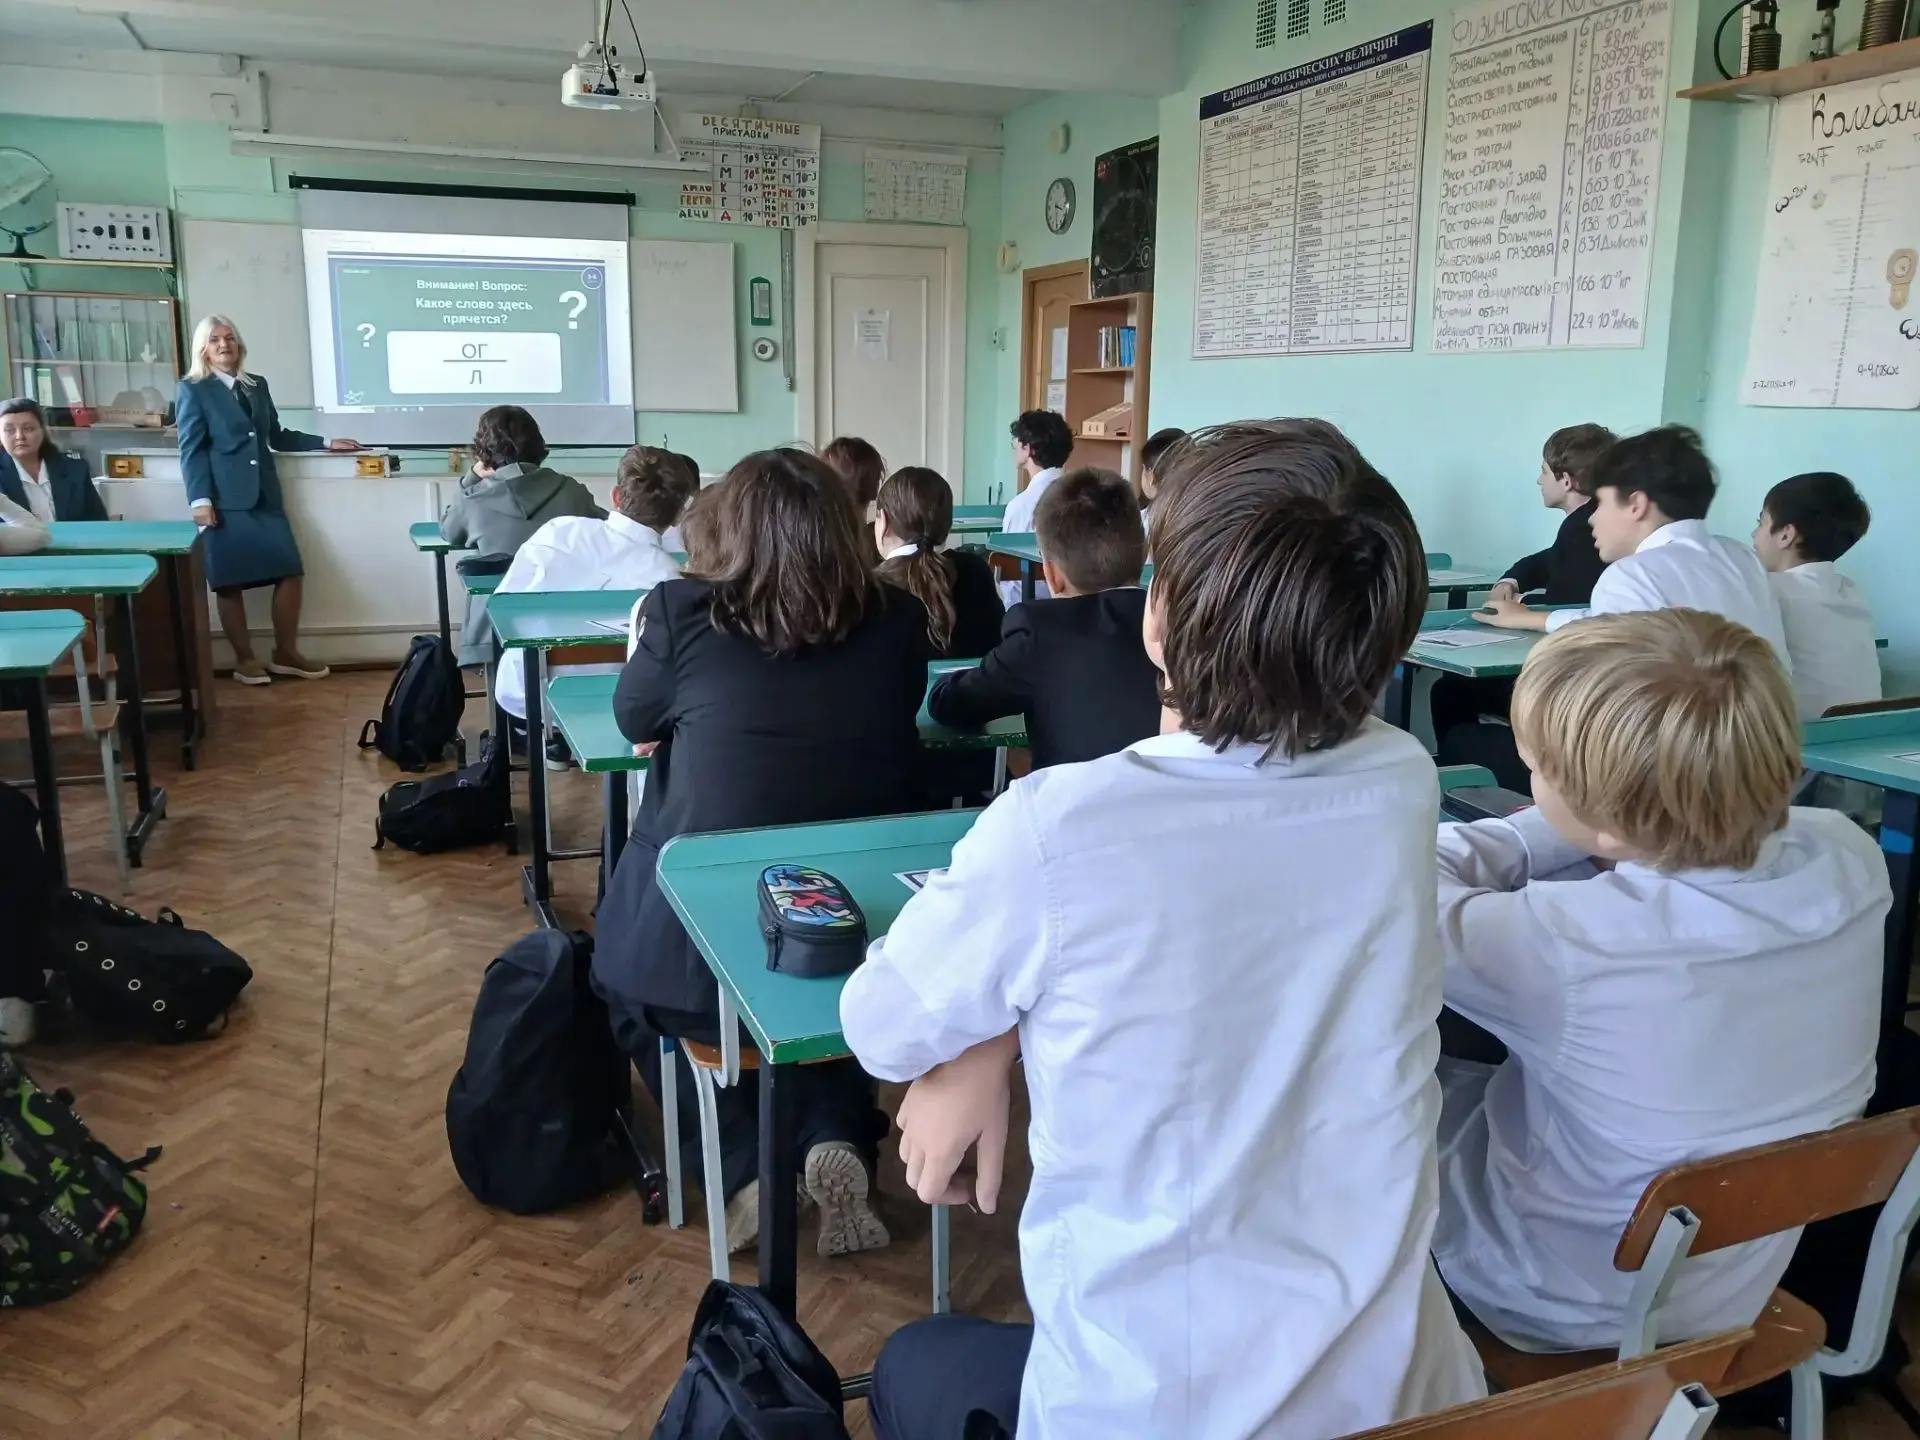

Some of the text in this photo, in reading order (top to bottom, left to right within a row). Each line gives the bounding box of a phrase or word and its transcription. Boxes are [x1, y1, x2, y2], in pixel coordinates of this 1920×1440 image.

[1222, 80, 1268, 102] ЕДИНИЦЫ
[1271, 56, 1340, 85] ФИЗИЧЕСКИХ
[1345, 35, 1399, 62] ВЕЛИЧИН
[1811, 80, 1920, 142] Колебан
[712, 127, 769, 140] ПРИСТАВКИ
[721, 154, 729, 163] Г
[720, 167, 732, 179] М
[720, 182, 727, 193] К
[416, 279, 528, 293] Внимание! Вопрос:
[415, 297, 534, 312] Какое слово здесь
[443, 314, 508, 327] прячется?
[461, 343, 488, 360] ОГ
[469, 369, 483, 385] Л
